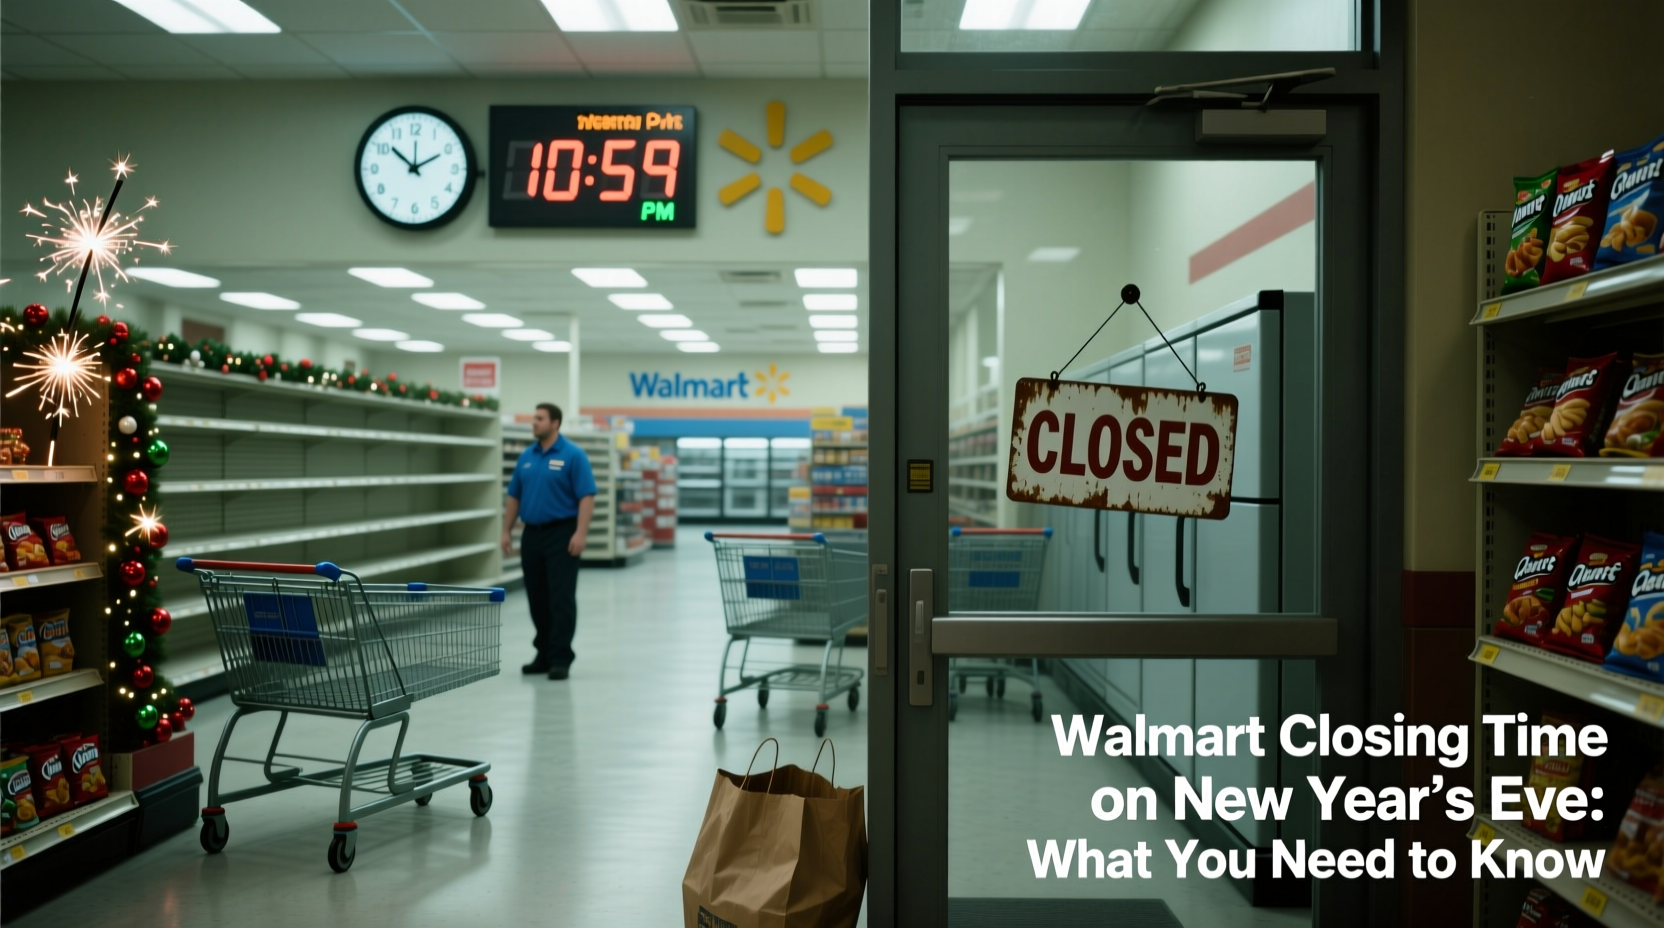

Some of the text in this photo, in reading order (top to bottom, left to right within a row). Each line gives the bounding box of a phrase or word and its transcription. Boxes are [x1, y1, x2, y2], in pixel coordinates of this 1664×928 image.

[527, 139, 681, 202] 10:59
[640, 201, 675, 221] PM
[629, 371, 750, 399] Walmart
[1027, 410, 1220, 486] CLOSED
